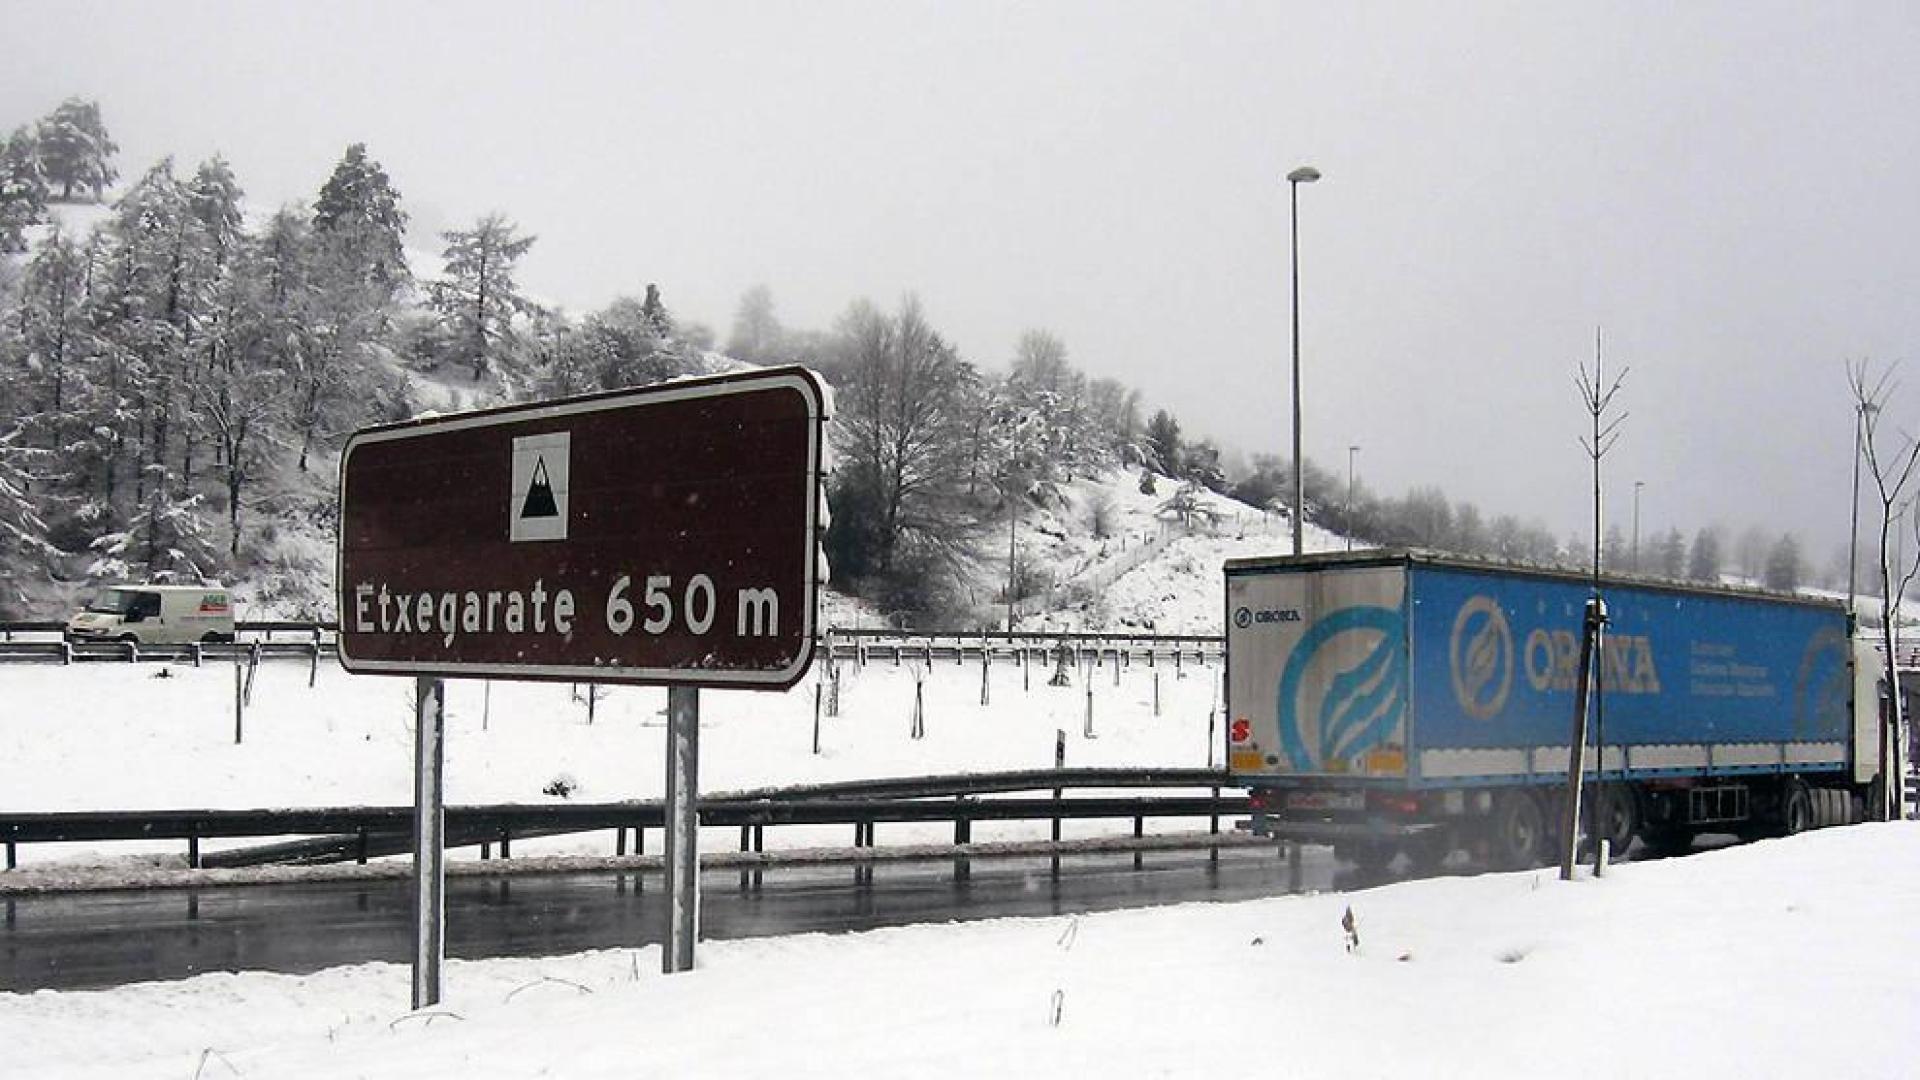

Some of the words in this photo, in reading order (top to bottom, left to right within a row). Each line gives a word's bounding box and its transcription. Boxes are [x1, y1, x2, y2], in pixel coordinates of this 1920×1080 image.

[356, 577, 576, 649] Etxegarate
[605, 574, 715, 636] 650
[736, 586, 779, 637] m
[1523, 628, 1661, 693] ORNA
